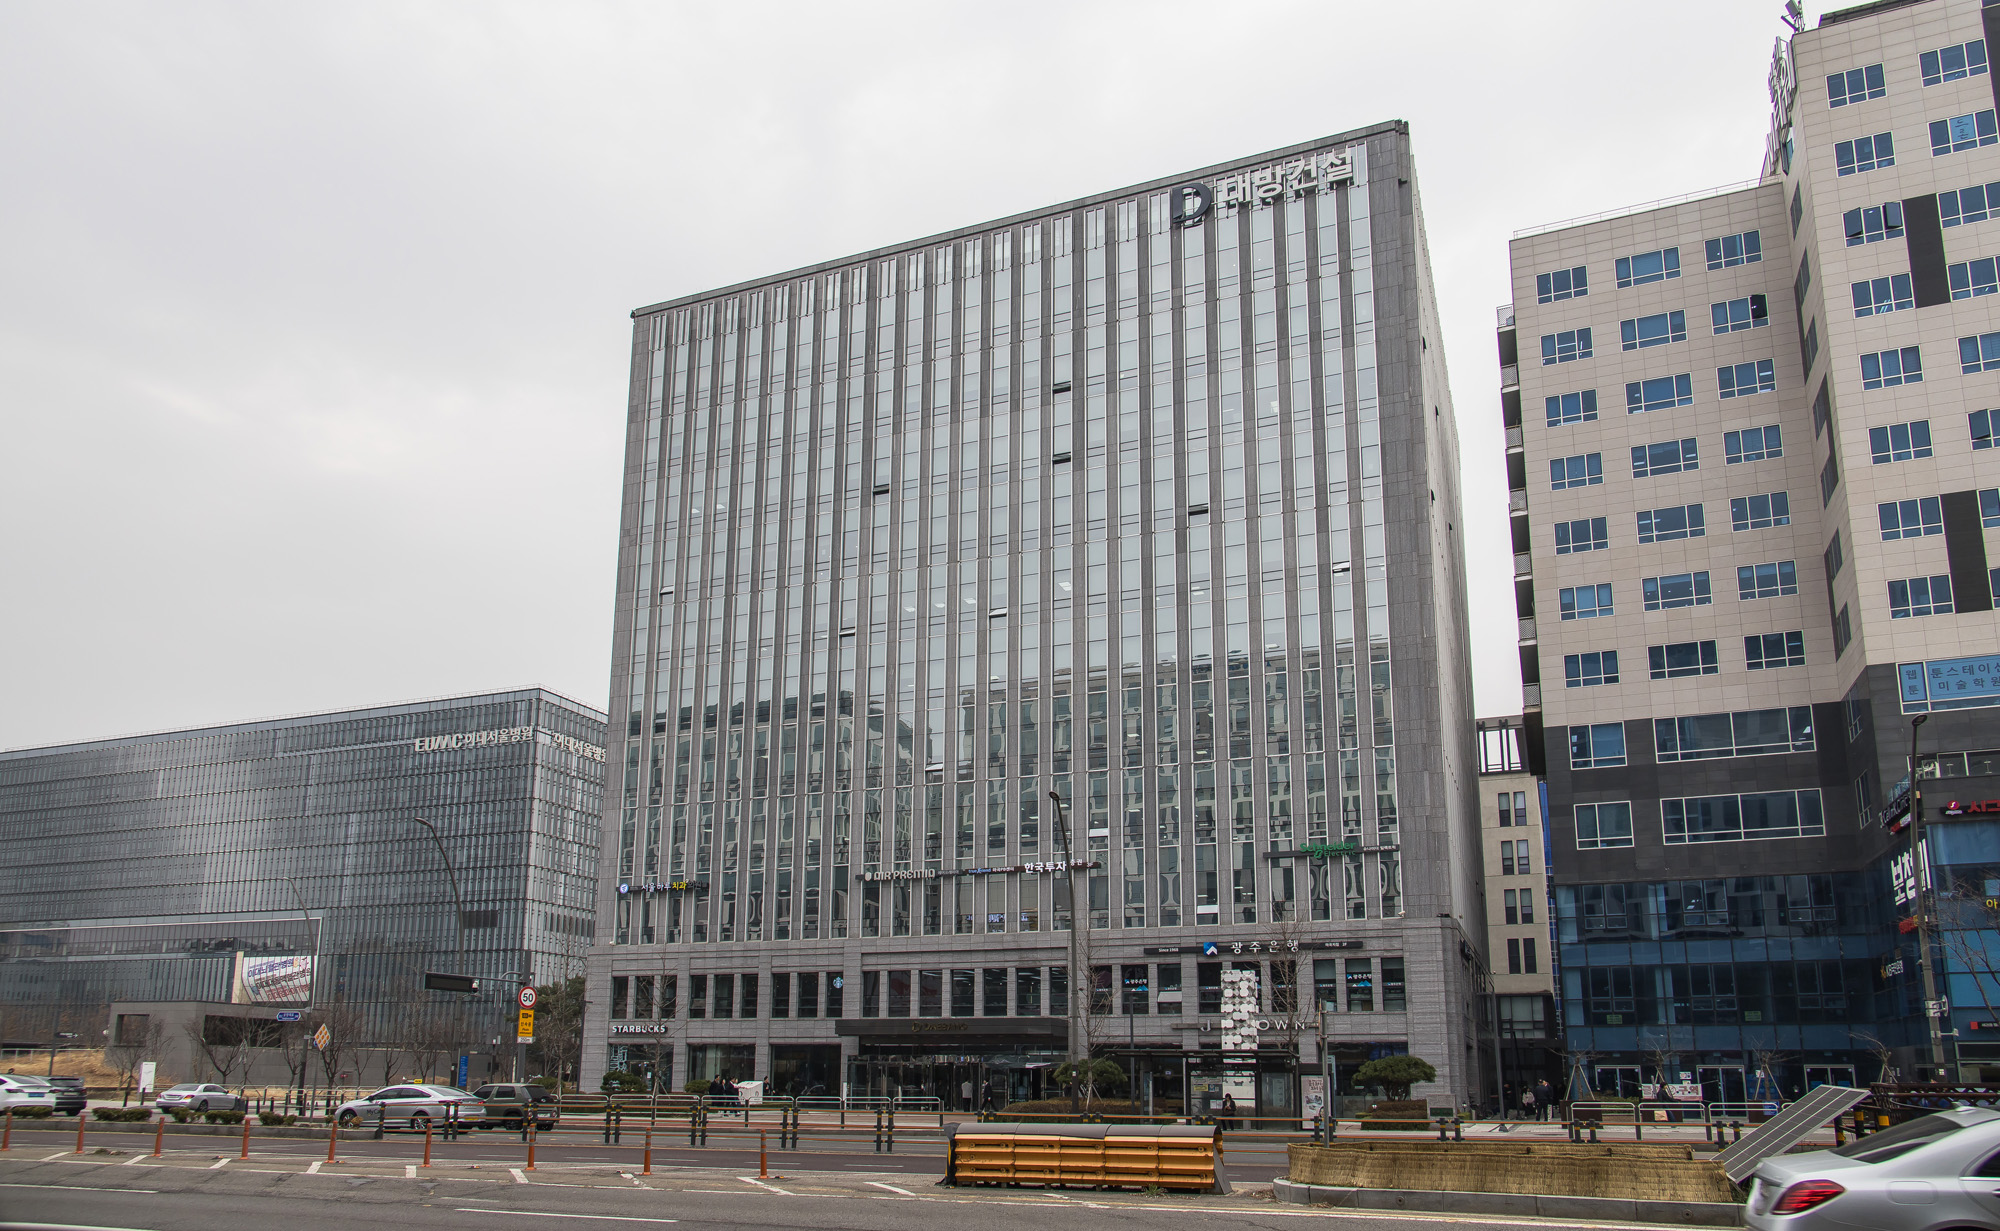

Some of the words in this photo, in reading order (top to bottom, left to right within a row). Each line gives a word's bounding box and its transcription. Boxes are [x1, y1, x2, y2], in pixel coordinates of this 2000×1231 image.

[1222, 149, 1354, 202] 대방건설
[1906, 669, 1919, 695] 웹툰
[1938, 676, 2000, 691] 미술학원
[415, 733, 463, 752] EUMC
[465, 725, 534, 747] 이대서울병원
[552, 731, 607, 763] 이대서울병
[1300, 840, 1357, 853] Schneider
[1024, 860, 1067, 874] 한국투자
[873, 871, 892, 881] AIR
[893, 868, 936, 880] PREMIA
[1230, 939, 1299, 954] 광주은행
[522, 993, 534, 1003] 50
[612, 1025, 667, 1033] STARBUCKS
[1257, 1019, 1306, 1031] OWN
